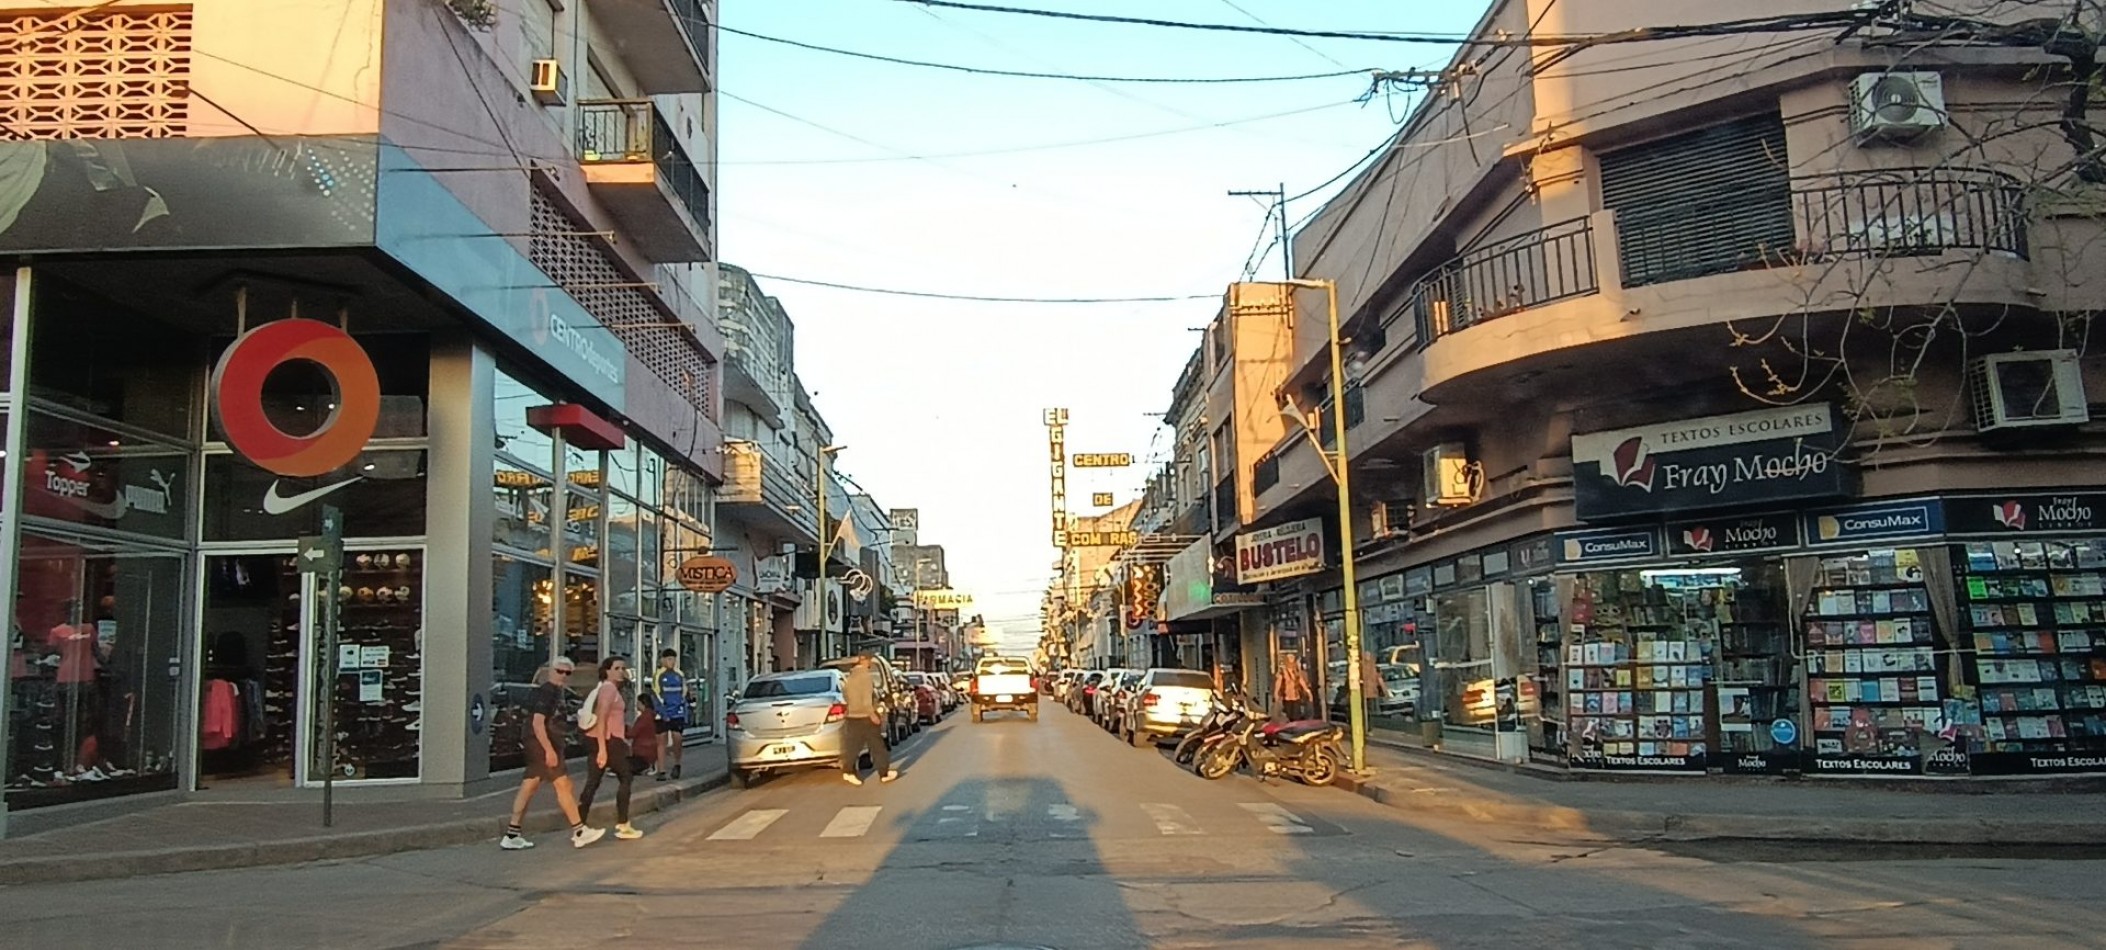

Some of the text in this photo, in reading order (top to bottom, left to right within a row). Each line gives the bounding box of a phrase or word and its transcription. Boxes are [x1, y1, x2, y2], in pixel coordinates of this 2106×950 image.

[1044, 408, 1068, 425] EL
[1660, 414, 1823, 445] TEXTOS ESCOLARES
[1074, 454, 1130, 466] CENTRO
[1662, 437, 1828, 494] Fray Mocho
[44, 469, 91, 497] Topper
[1093, 494, 1112, 505] DE
[2038, 497, 2092, 523] Mocho
[1725, 519, 1777, 544] Mocho
[1844, 514, 1922, 531] ConsuMax
[1240, 532, 1320, 572] BUSTELO
[1584, 539, 1648, 553] ConsuMax
[680, 565, 734, 580] MISTICA
